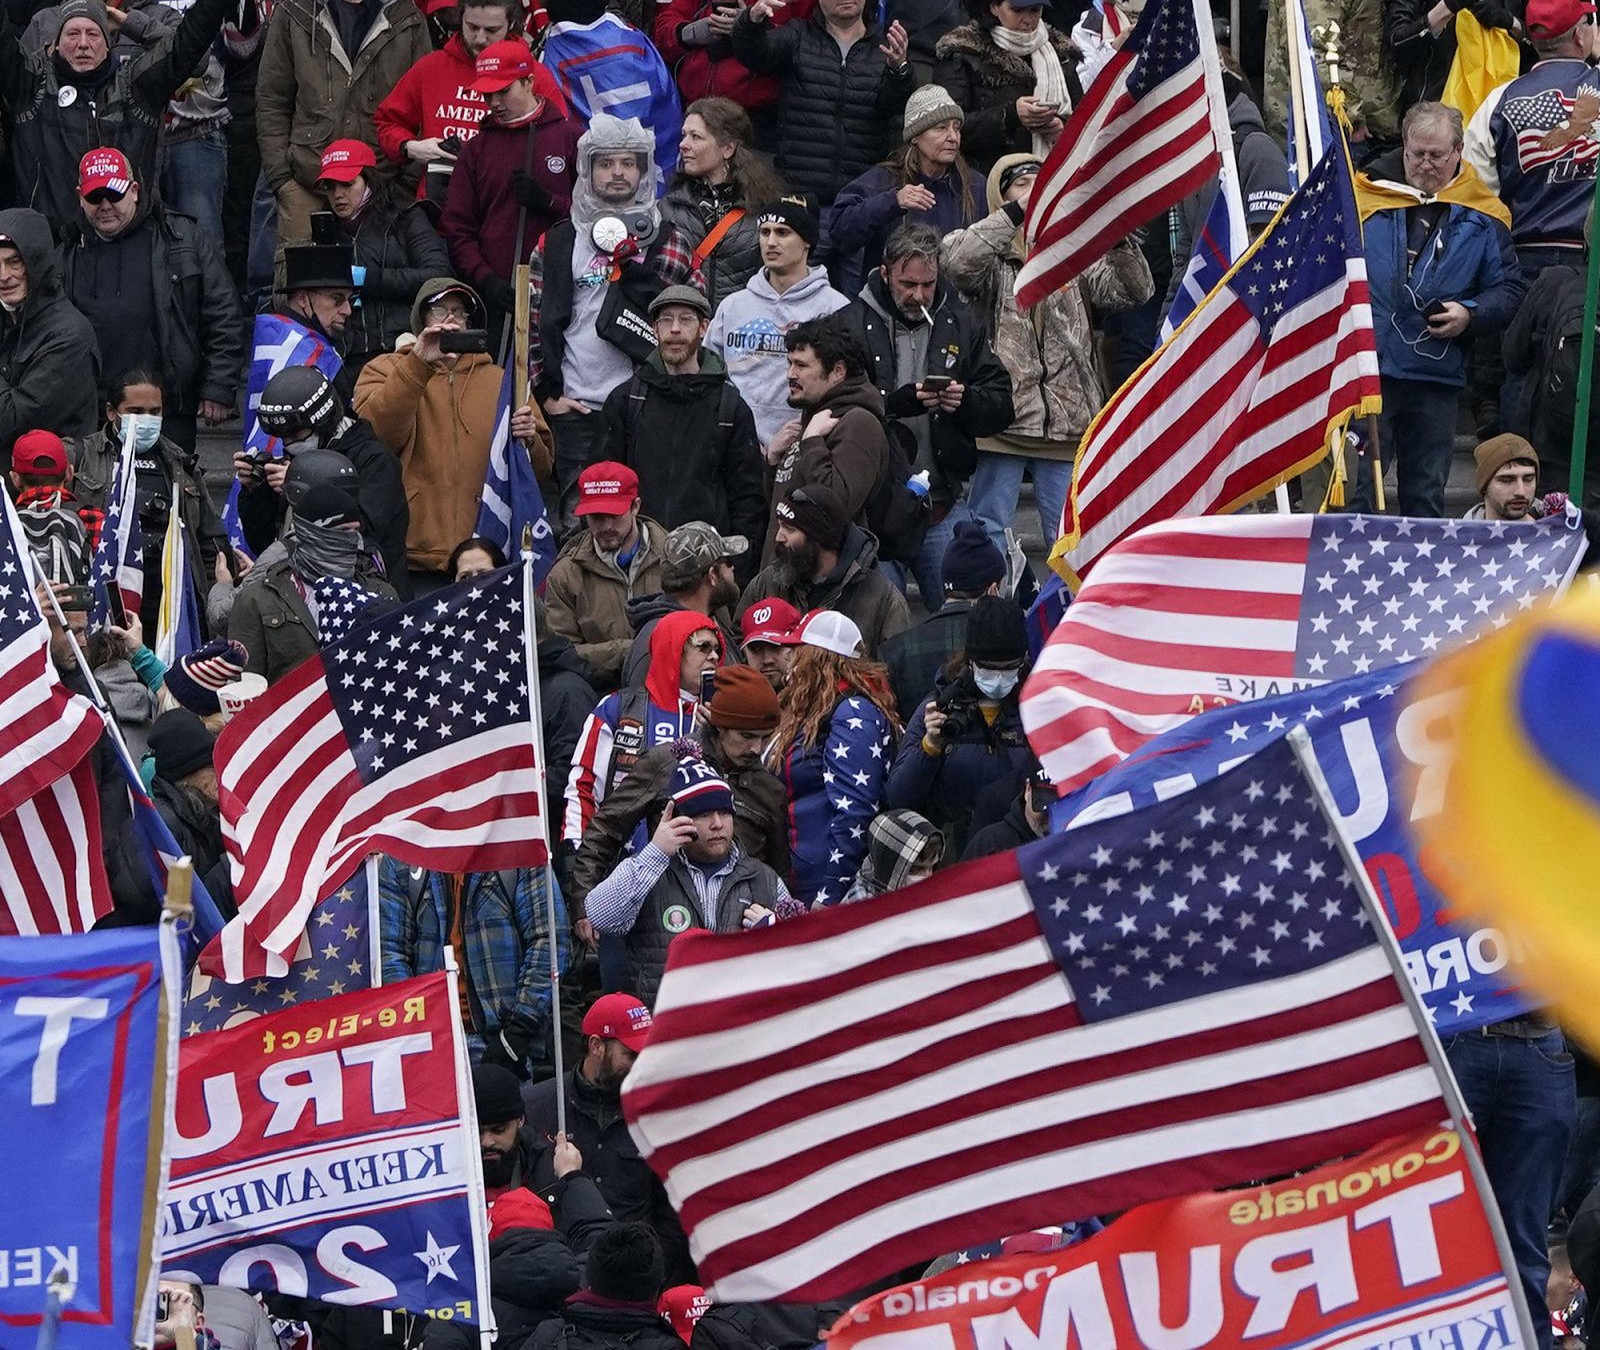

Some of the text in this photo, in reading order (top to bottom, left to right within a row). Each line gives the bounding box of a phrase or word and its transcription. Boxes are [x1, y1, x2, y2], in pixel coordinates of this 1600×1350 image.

[443, 126, 480, 143] GRE
[86, 164, 120, 177] TRUMP
[616, 316, 643, 337] ESCAPE
[726, 331, 750, 349] OUT
[309, 397, 335, 425] PRESS
[134, 460, 156, 470] RESS
